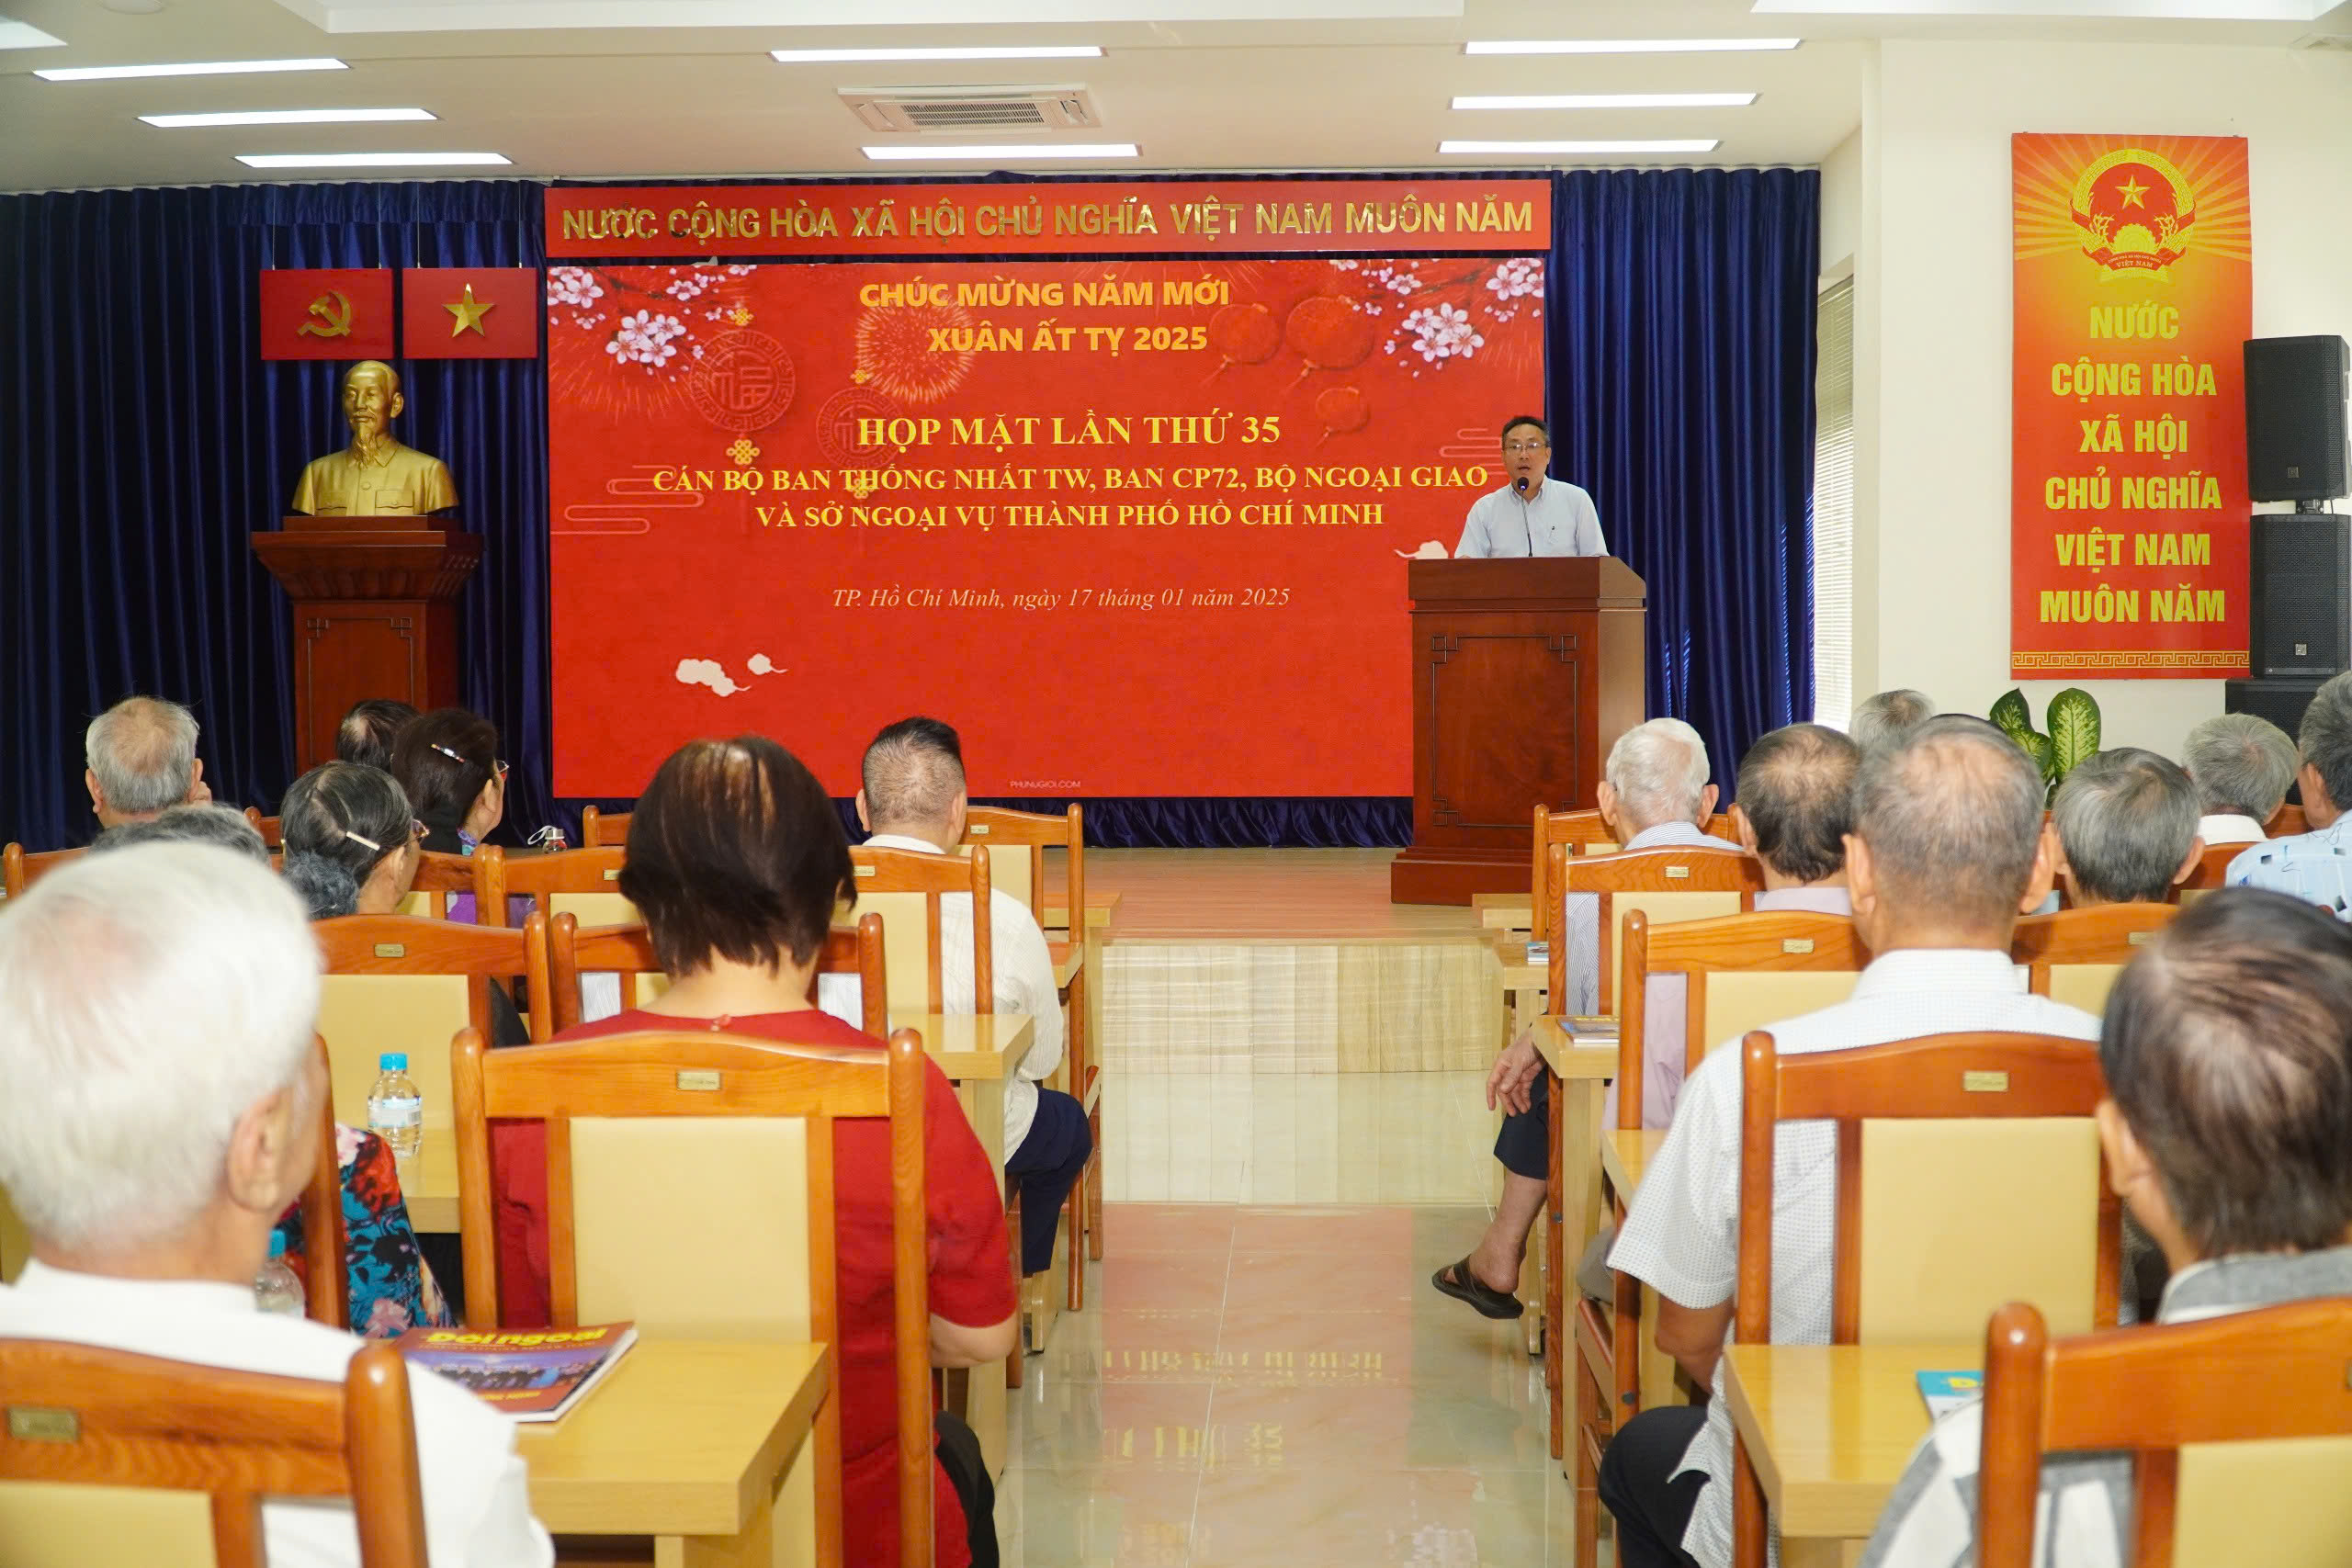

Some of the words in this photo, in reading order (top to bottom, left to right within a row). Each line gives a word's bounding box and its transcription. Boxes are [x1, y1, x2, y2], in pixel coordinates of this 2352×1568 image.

[668, 200, 761, 246] CỘNG
[770, 198, 839, 238] HÒA
[852, 198, 899, 238] XÃ
[910, 197, 966, 243] HỘI
[974, 195, 1043, 236] CHỦ
[1055, 196, 1159, 235] NGHĨA
[1170, 194, 1244, 242] VIỆT
[1255, 202, 1332, 234] NAM
[1345, 193, 1446, 234] MUÔN
[1455, 193, 1532, 232] NĂM
[859, 276, 949, 308] CHÚC
[955, 275, 1064, 307] MỪNG
[1073, 274, 1153, 307] NĂM
[1163, 273, 1228, 306] MỚI
[928, 320, 1024, 353] XUÂN
[1032, 318, 1077, 352] ẤT
[1083, 327, 1125, 357] TỴ
[1134, 326, 1207, 351] 2025
[2089, 299, 2180, 339] NƯỚC
[2052, 355, 2142, 403] CỘNG
[2152, 355, 2217, 397] HÒA
[857, 417, 942, 454] HỌP
[949, 413, 1041, 453] MẶT
[1050, 409, 1133, 445] LẦN
[1143, 407, 1234, 445] THỨ
[1241, 416, 1281, 444] 35
[2079, 413, 2124, 453] XÃ
[2134, 412, 2188, 460] HỘI
[652, 465, 714, 491] CÁN
[722, 467, 765, 496] BỘ
[772, 469, 831, 491] BAN
[838, 463, 947, 491] THỐNG
[954, 462, 1037, 490] NHẤT
[1043, 468, 1096, 493] TW,
[1103, 468, 1164, 489] BAN
[1172, 468, 1248, 492] CP72,
[1255, 464, 1296, 493] BỘ
[1304, 467, 1402, 493] NGOẠI
[1410, 466, 1489, 488] GIAO
[2045, 466, 2110, 510] CHỦ
[2122, 470, 2222, 510] NGHĨA
[755, 501, 797, 527] VÀ
[805, 500, 844, 527] SỞ
[850, 506, 948, 532] NGOẠI
[955, 506, 996, 532] VỤ
[1003, 500, 1109, 526] THÀNH
[1116, 499, 1180, 525] PHỐ
[1187, 498, 1232, 525] HỒ
[1239, 499, 1294, 525] CHÍ
[1302, 503, 1384, 525] MINH
[2055, 526, 2125, 573] VIỆT
[2135, 534, 2211, 566] NAM
[832, 589, 862, 607] TP.
[869, 583, 899, 607] Hồ
[907, 589, 944, 607] Chí
[948, 589, 1004, 609] Minh,
[1012, 588, 1061, 611] ngày
[1069, 589, 1093, 606] 17
[1098, 588, 1155, 611] tháng
[1161, 588, 1184, 606] 01
[1192, 588, 1234, 606] năm
[1240, 587, 1290, 605] 2025
[2040, 583, 2139, 623] MUÔN
[2150, 583, 2225, 622] NĂM
